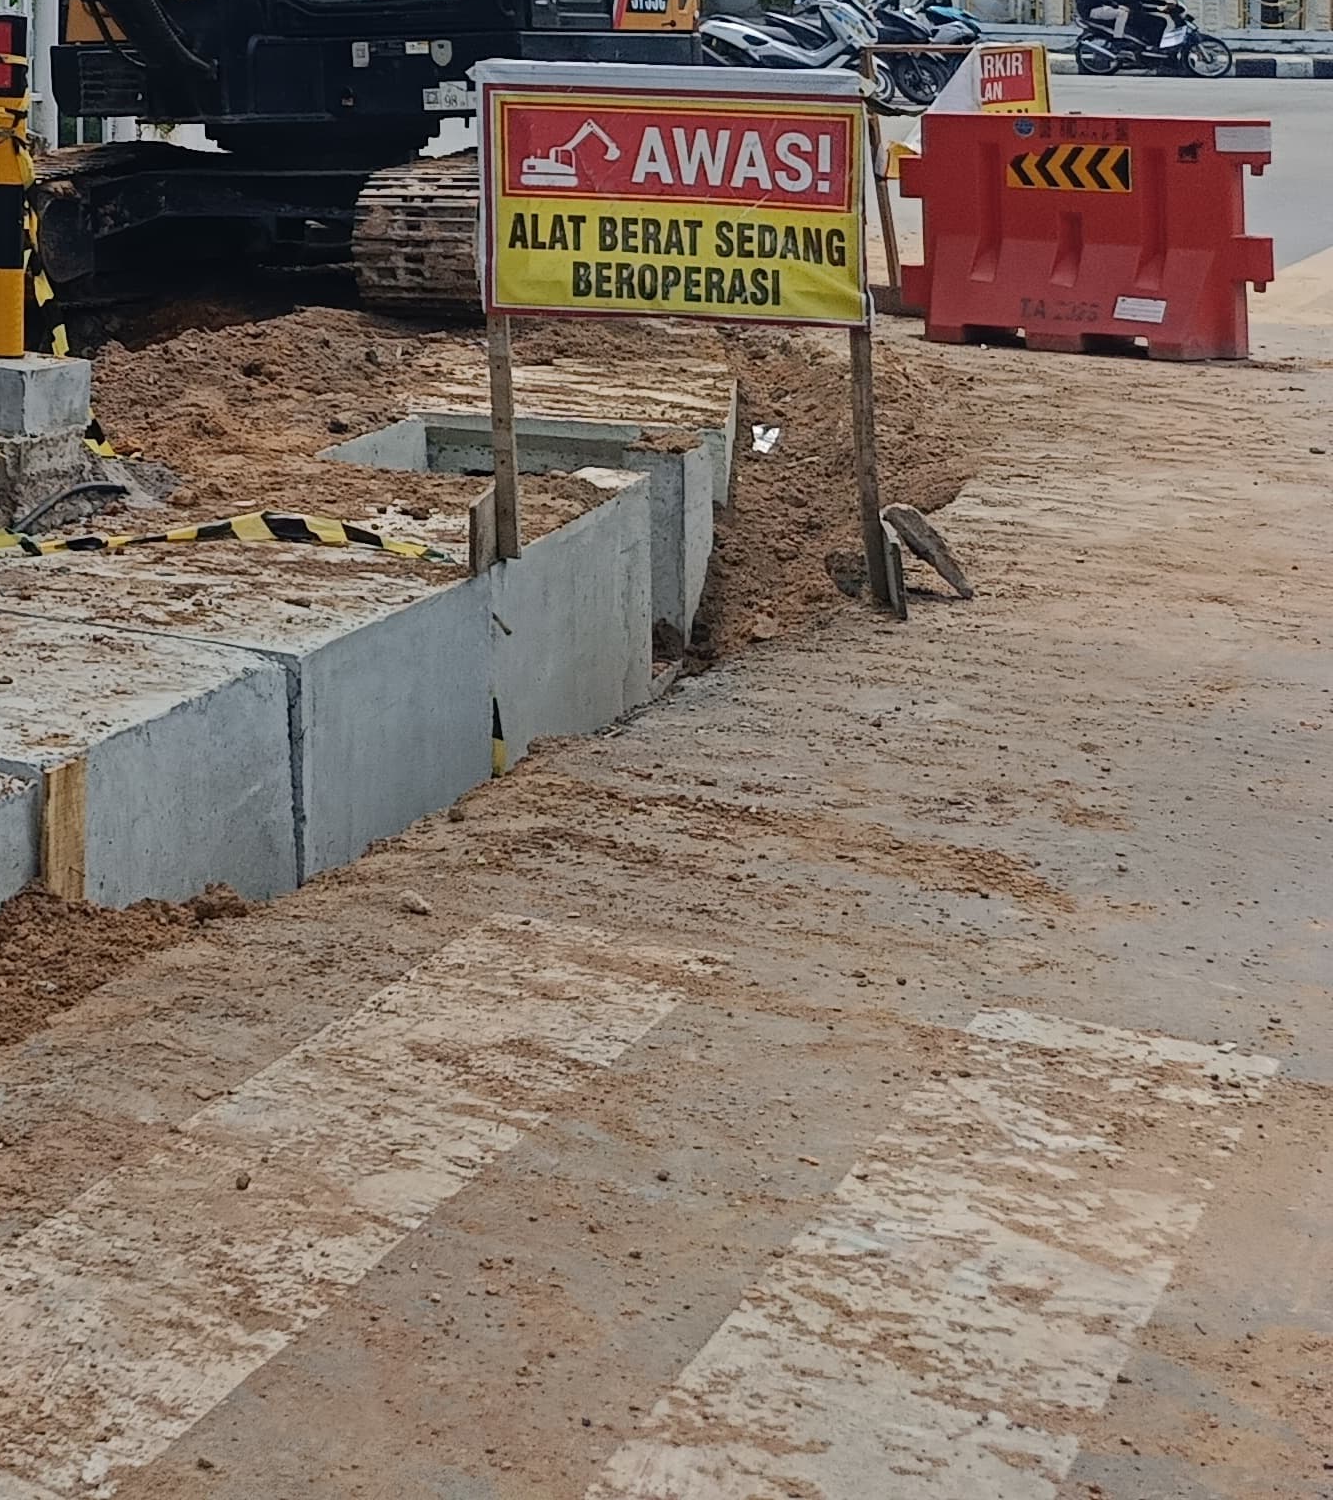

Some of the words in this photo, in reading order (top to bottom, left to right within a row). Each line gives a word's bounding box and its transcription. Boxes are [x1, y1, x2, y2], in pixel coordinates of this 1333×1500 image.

[981, 52, 1023, 78] RKIR
[631, 127, 831, 193] AWAS!
[508, 212, 586, 251] ALAT
[598, 216, 703, 256] BERAT
[714, 220, 846, 267] SEDANG
[572, 261, 781, 306] BEROPERASI
